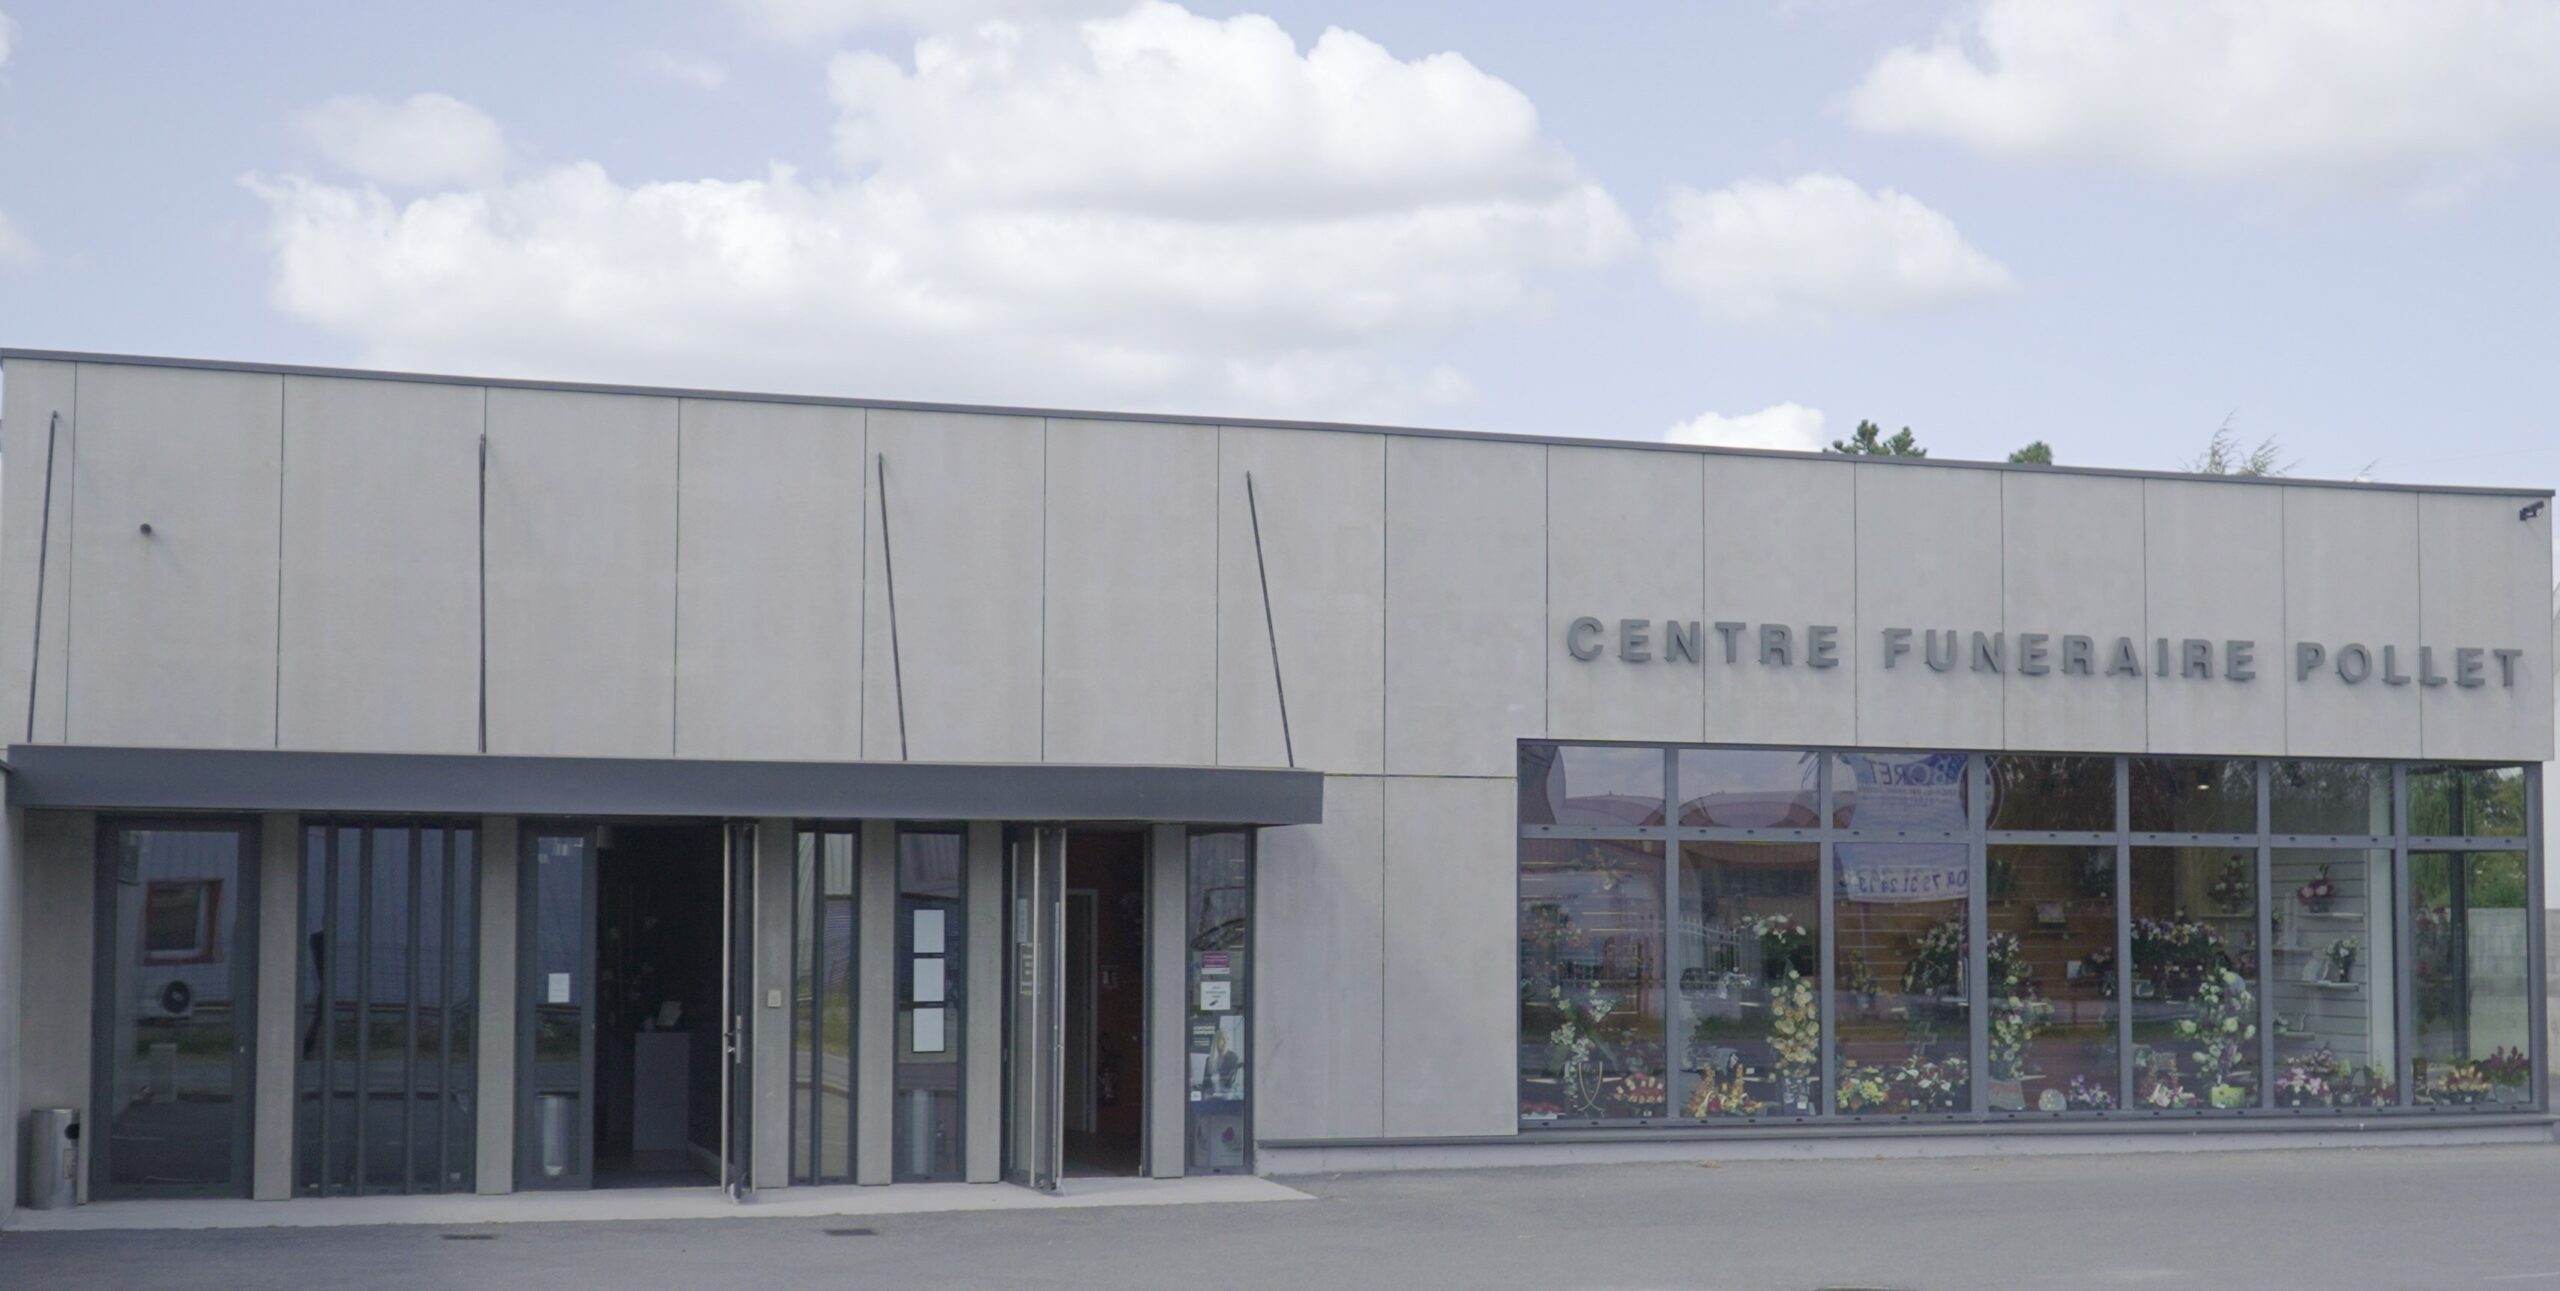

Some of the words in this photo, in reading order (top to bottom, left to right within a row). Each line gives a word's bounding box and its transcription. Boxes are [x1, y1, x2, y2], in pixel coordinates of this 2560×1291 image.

[1566, 616, 1839, 668] CENTRE
[1882, 627, 2256, 681] FUNERAIRE
[2296, 641, 2523, 688] POLLET
